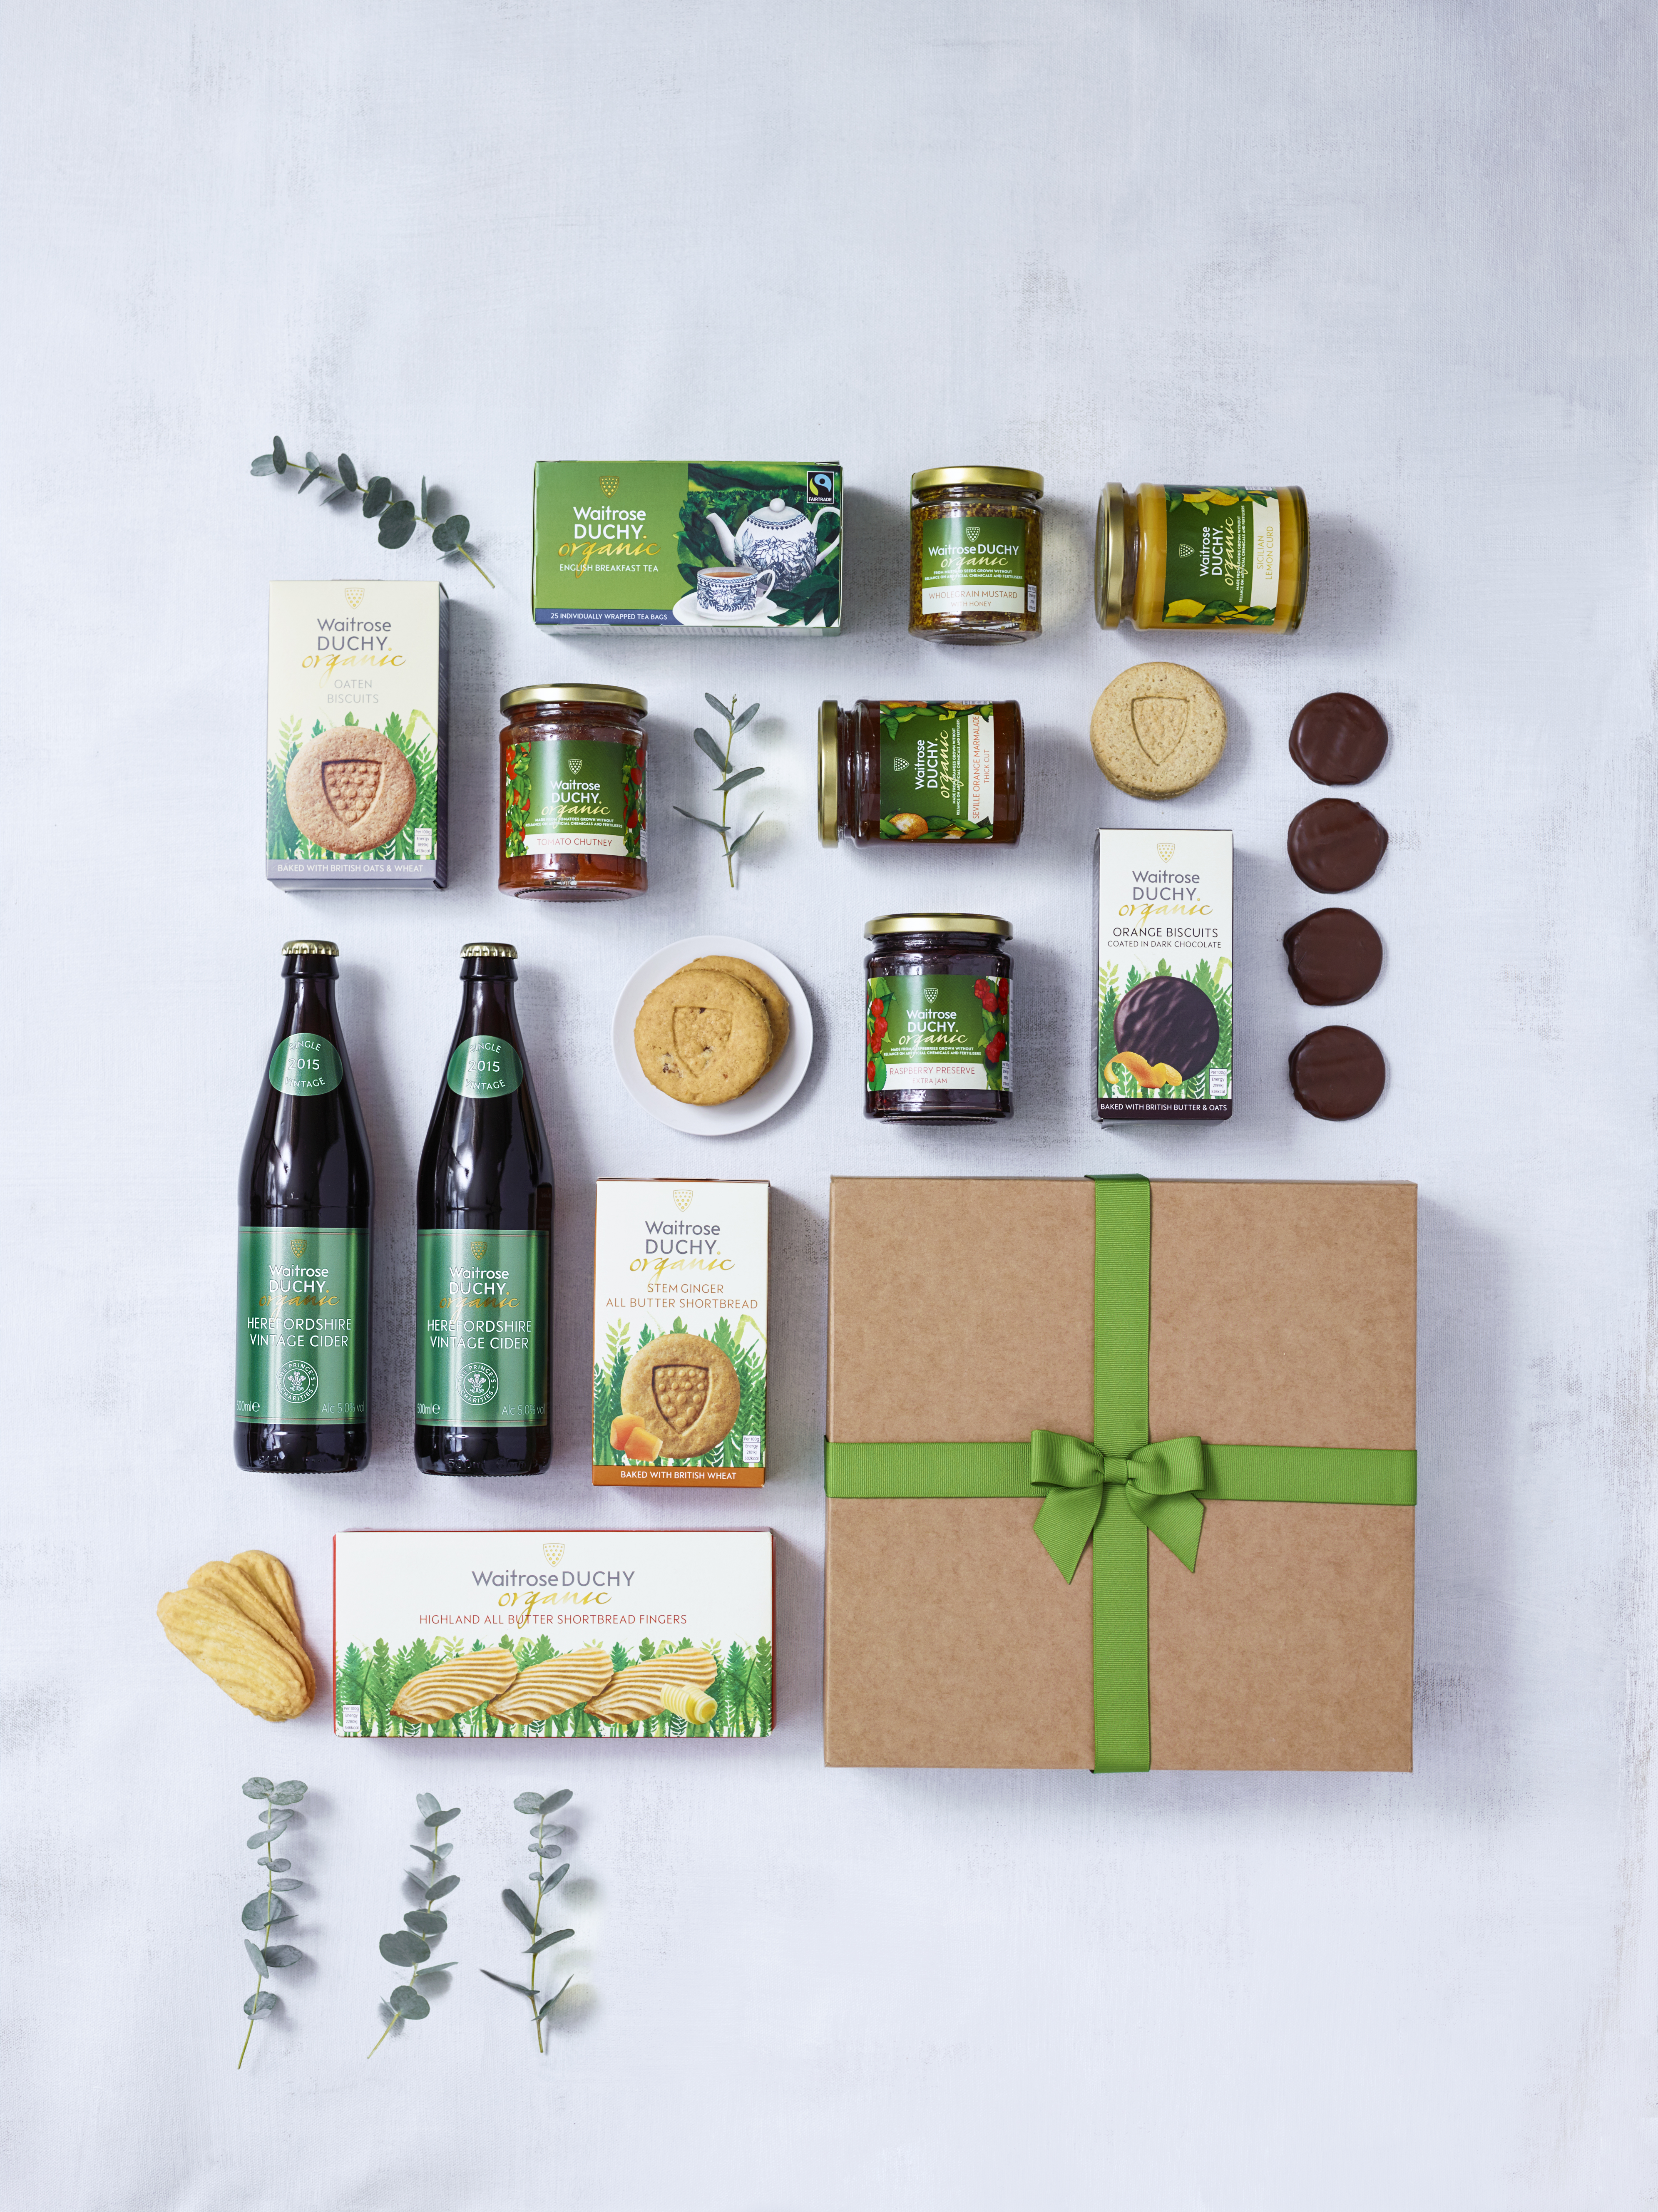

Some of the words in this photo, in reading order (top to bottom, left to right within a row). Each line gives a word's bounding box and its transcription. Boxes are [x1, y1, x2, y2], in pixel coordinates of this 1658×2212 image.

[573, 505, 646, 521] Waitrose
[558, 535, 661, 578] organic
[928, 544, 975, 556] Waitrose
[978, 544, 1019, 555] DUCHY
[1199, 527, 1210, 576] Waitrose
[1220, 516, 1248, 586] organic
[941, 556, 1008, 581] organic
[317, 617, 391, 632] Waitrose
[302, 648, 406, 688] organic
[334, 680, 372, 688] OATEN
[327, 694, 378, 703] BISCUITS
[915, 740, 925, 790] Waitrose
[935, 730, 964, 799] organic
[550, 779, 600, 791] Waitrose
[541, 801, 611, 829] organic
[1132, 870, 1200, 883] Waitrose
[1119, 898, 1213, 935] organic
[1113, 928, 1162, 937] ORANGE
[1166, 928, 1218, 938] BISCUITS
[906, 1008, 957, 1019] Waitrose
[289, 1040, 321, 1051] SINGLE
[470, 1042, 501, 1053] SINGLE
[898, 1029, 968, 1058] organic
[288, 1058, 320, 1070] 2015
[468, 1060, 500, 1072] 2015
[285, 1077, 325, 1088] VINTAGE
[465, 1078, 506, 1090] VINTAGE
[645, 1220, 720, 1235] Waitrose
[269, 1264, 328, 1277] Waitrose
[449, 1266, 509, 1280] Waitrose
[629, 1251, 735, 1292] organic
[648, 1284, 677, 1293] STEM
[681, 1284, 723, 1293] GINGER
[259, 1290, 340, 1322] organic
[439, 1292, 520, 1324] organic
[606, 1298, 625, 1307] ALL
[630, 1298, 675, 1308] BUTTER
[680, 1298, 758, 1308] SHORTBREAD
[248, 1317, 351, 1330] HEREFORDSHIRE
[428, 1319, 532, 1332] HEREFORDSHIRE
[250, 1334, 304, 1347] VINTAGE
[310, 1335, 348, 1347] CIDER
[430, 1336, 485, 1348] VINTAGE
[490, 1337, 528, 1349] CIDER
[278, 1368, 288, 1380] THE
[459, 1369, 468, 1382] THE
[281, 1388, 313, 1401] CHARITIES
[461, 1390, 493, 1403] CHARITIES
[321, 1402, 335, 1413] Alc
[338, 1403, 355, 1413] 5.0%
[502, 1404, 515, 1415] Alc
[518, 1405, 535, 1415] 5.0%
[472, 1569, 559, 1587] Waitrose
[562, 1571, 635, 1587] DUCHY
[498, 1591, 612, 1629] organic
[420, 1615, 480, 1624] HIGHLAND
[484, 1615, 504, 1624] ALL
[508, 1615, 553, 1624] BUTTER
[557, 1615, 635, 1624] SHORTBREAD
[640, 1615, 686, 1624] FINGERS
